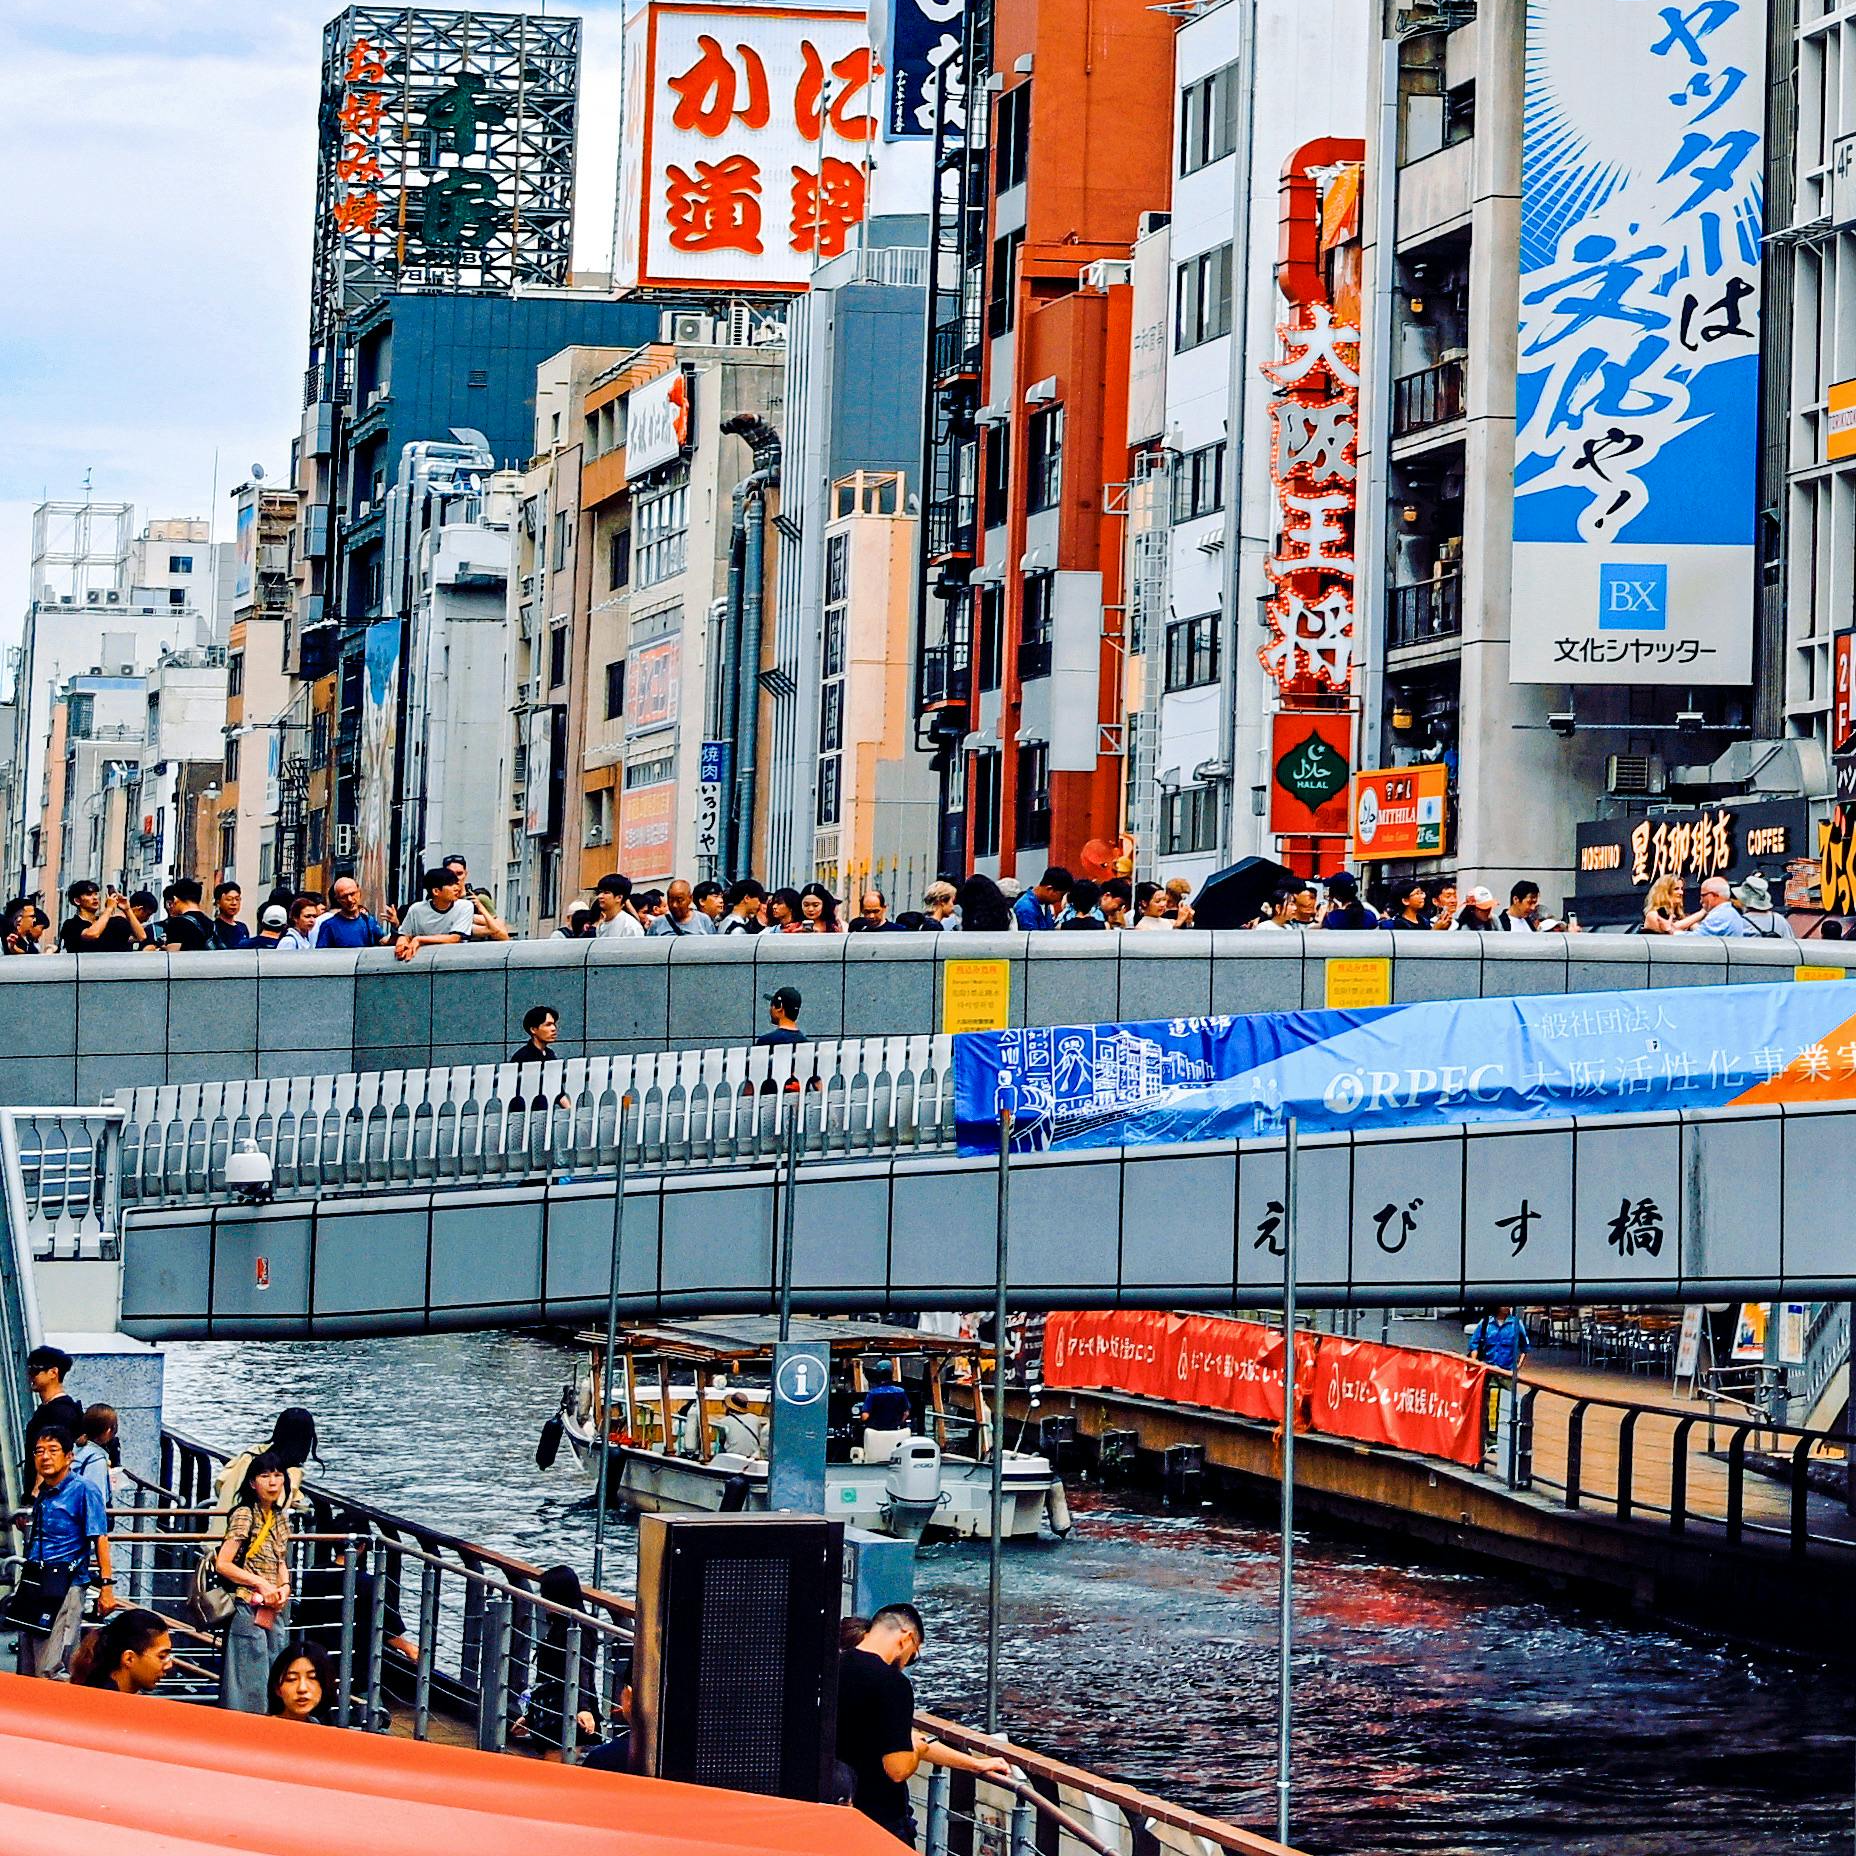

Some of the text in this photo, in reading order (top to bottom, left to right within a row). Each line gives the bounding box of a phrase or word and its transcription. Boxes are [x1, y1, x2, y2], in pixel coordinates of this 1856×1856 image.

[667, 34, 884, 141] かに
[1263, 300, 1361, 688] 大阪王将
[1609, 581, 1659, 612] BX
[1839, 653, 1848, 741] 2F
[701, 746, 718, 779] 焼肉
[1297, 781, 1329, 789] HALAL
[700, 785, 717, 852] いろりや
[1377, 807, 1417, 825] MITHILA
[1631, 810, 1730, 886] 星乃珈琲店
[1748, 826, 1785, 857] COFFEE
[1520, 1003, 1676, 1038] 一般社団法人
[1253, 1197, 1664, 1257] えびす橋
